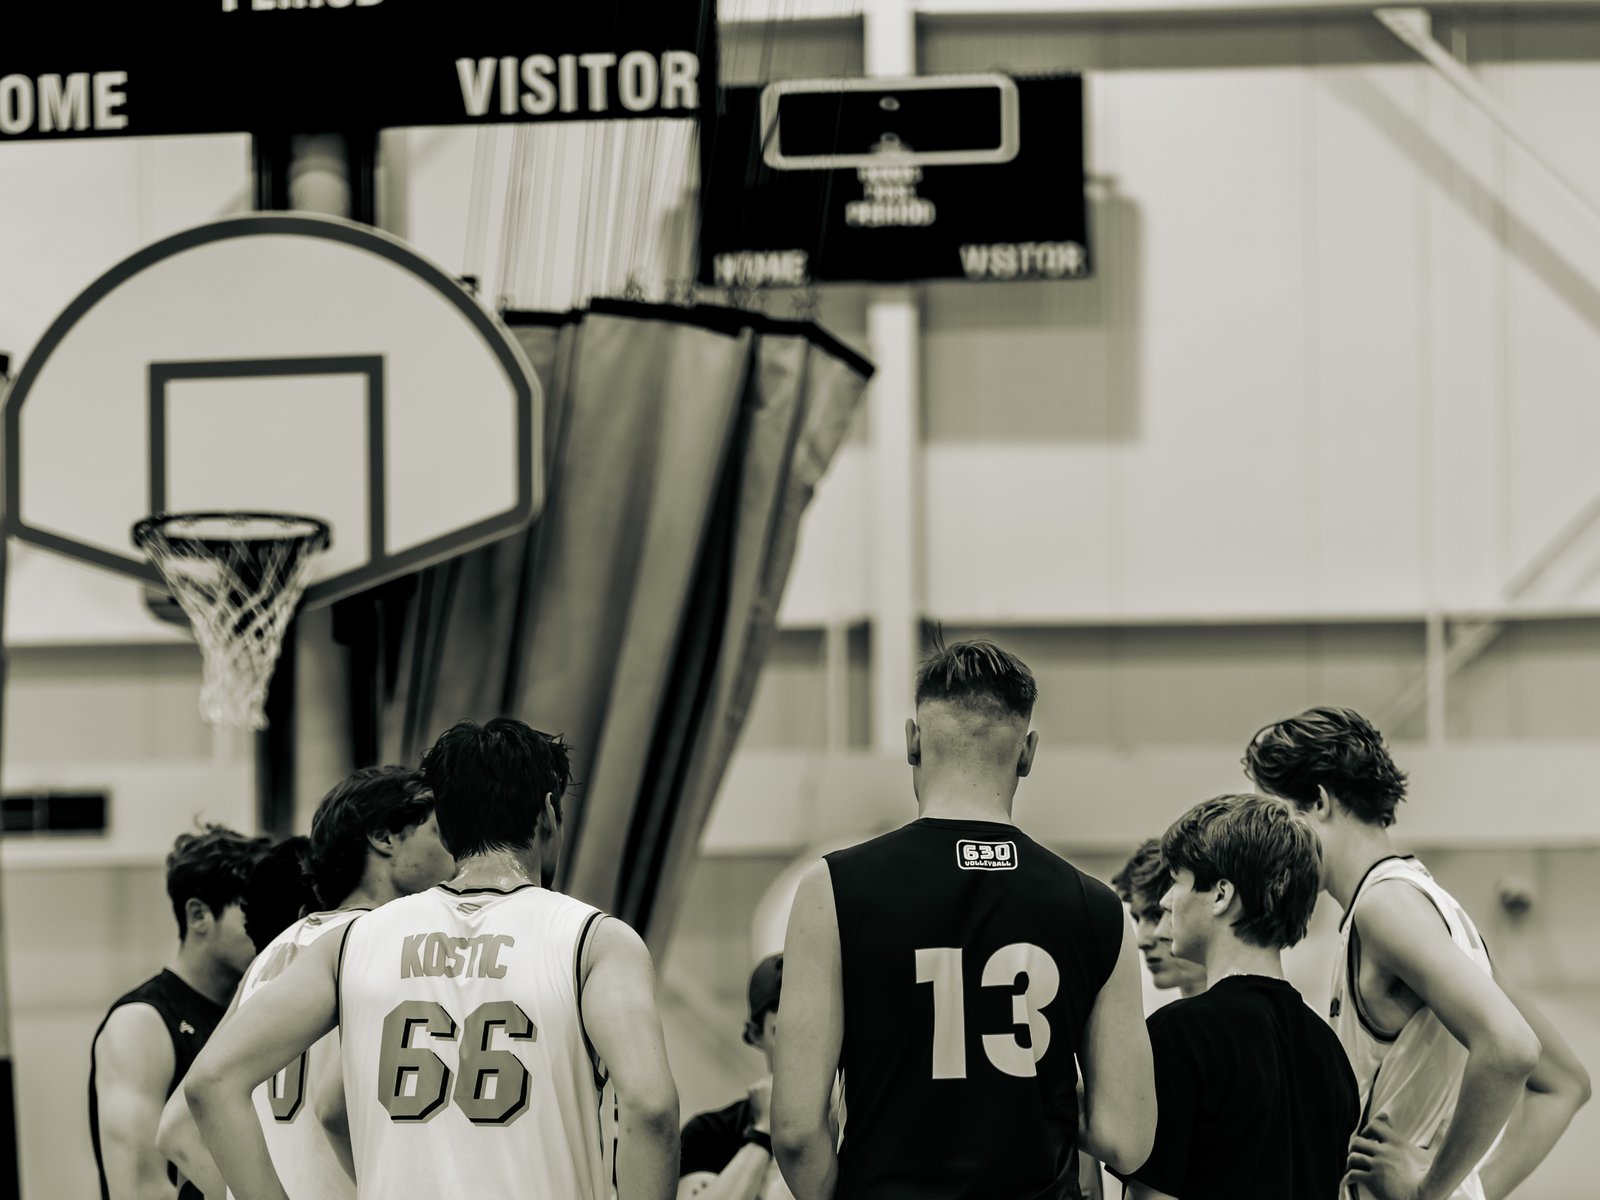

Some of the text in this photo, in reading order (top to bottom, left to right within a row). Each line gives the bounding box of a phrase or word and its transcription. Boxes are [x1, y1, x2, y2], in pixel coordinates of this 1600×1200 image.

[455, 51, 700, 116] VISITOR
[963, 844, 1010, 860] 630
[401, 932, 514, 979] KOSTIC
[915, 942, 1060, 1079] 13
[378, 1000, 538, 1127] 66
